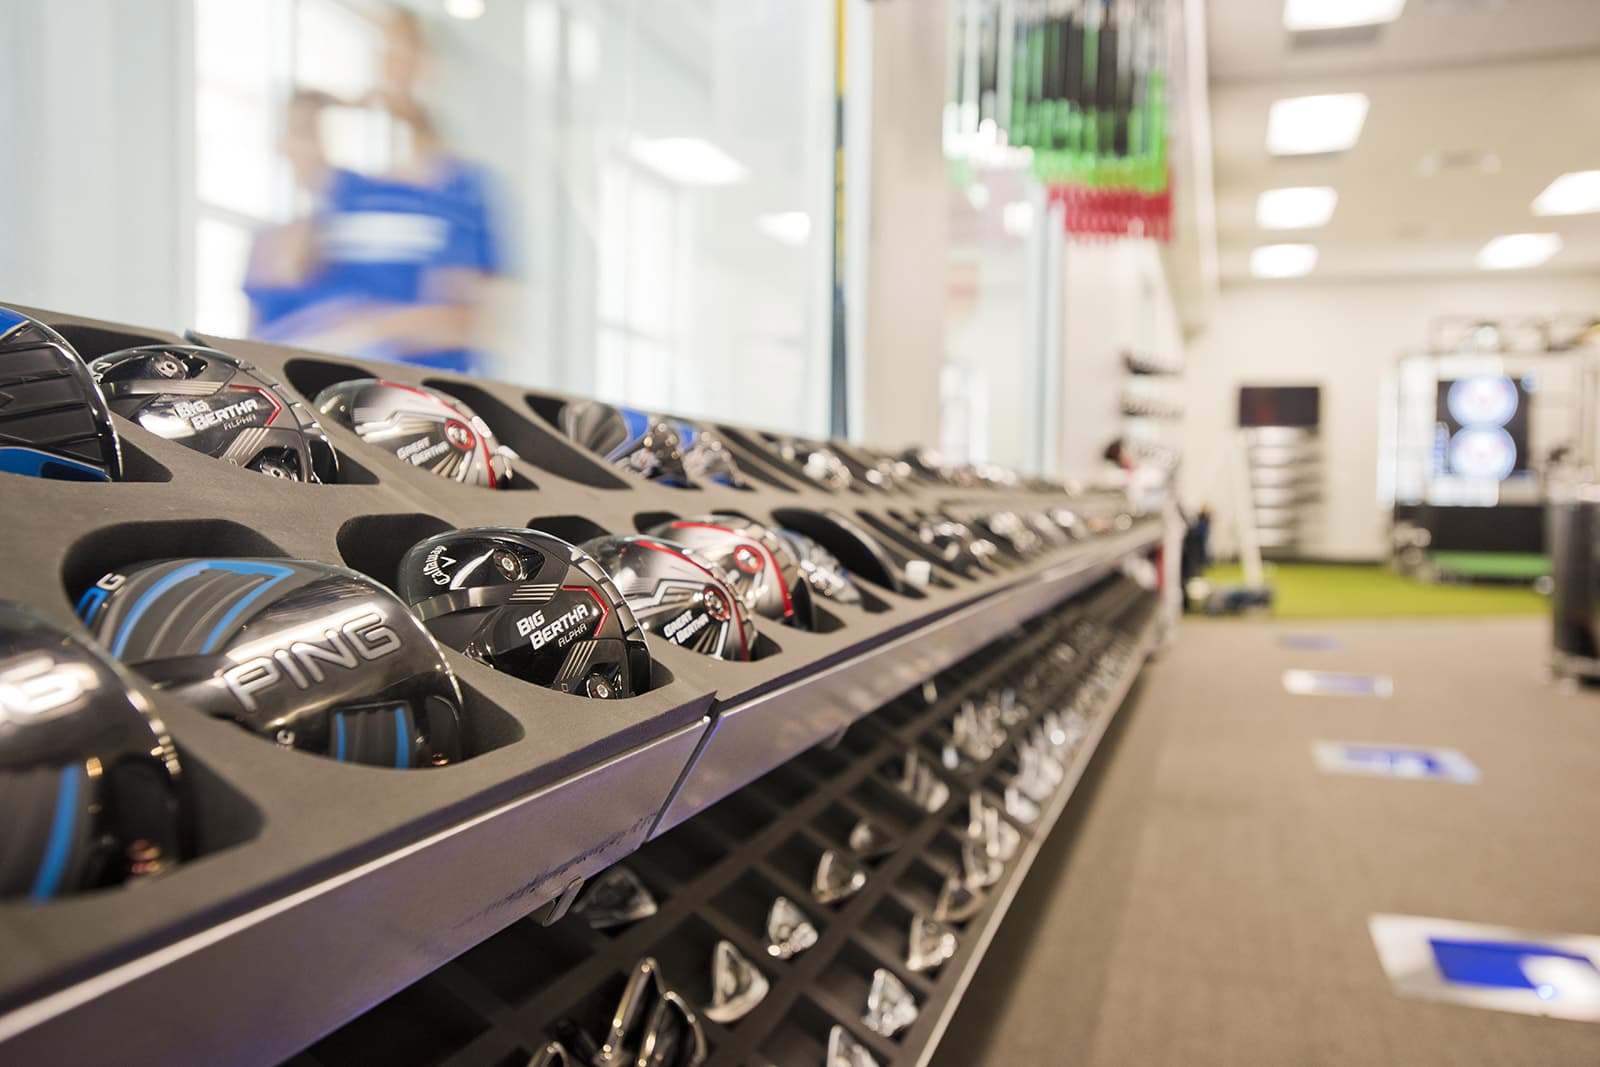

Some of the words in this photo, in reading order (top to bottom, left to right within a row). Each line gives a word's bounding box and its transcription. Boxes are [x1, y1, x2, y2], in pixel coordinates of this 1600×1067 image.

[174, 400, 211, 418] BIG
[191, 399, 258, 431] BERTHA
[223, 414, 257, 431] ALPHA
[423, 545, 450, 585] Callaway
[516, 610, 545, 637] BIG
[529, 604, 589, 650] BERTHA
[558, 623, 587, 647] ALPHA
[223, 612, 402, 712] PING
